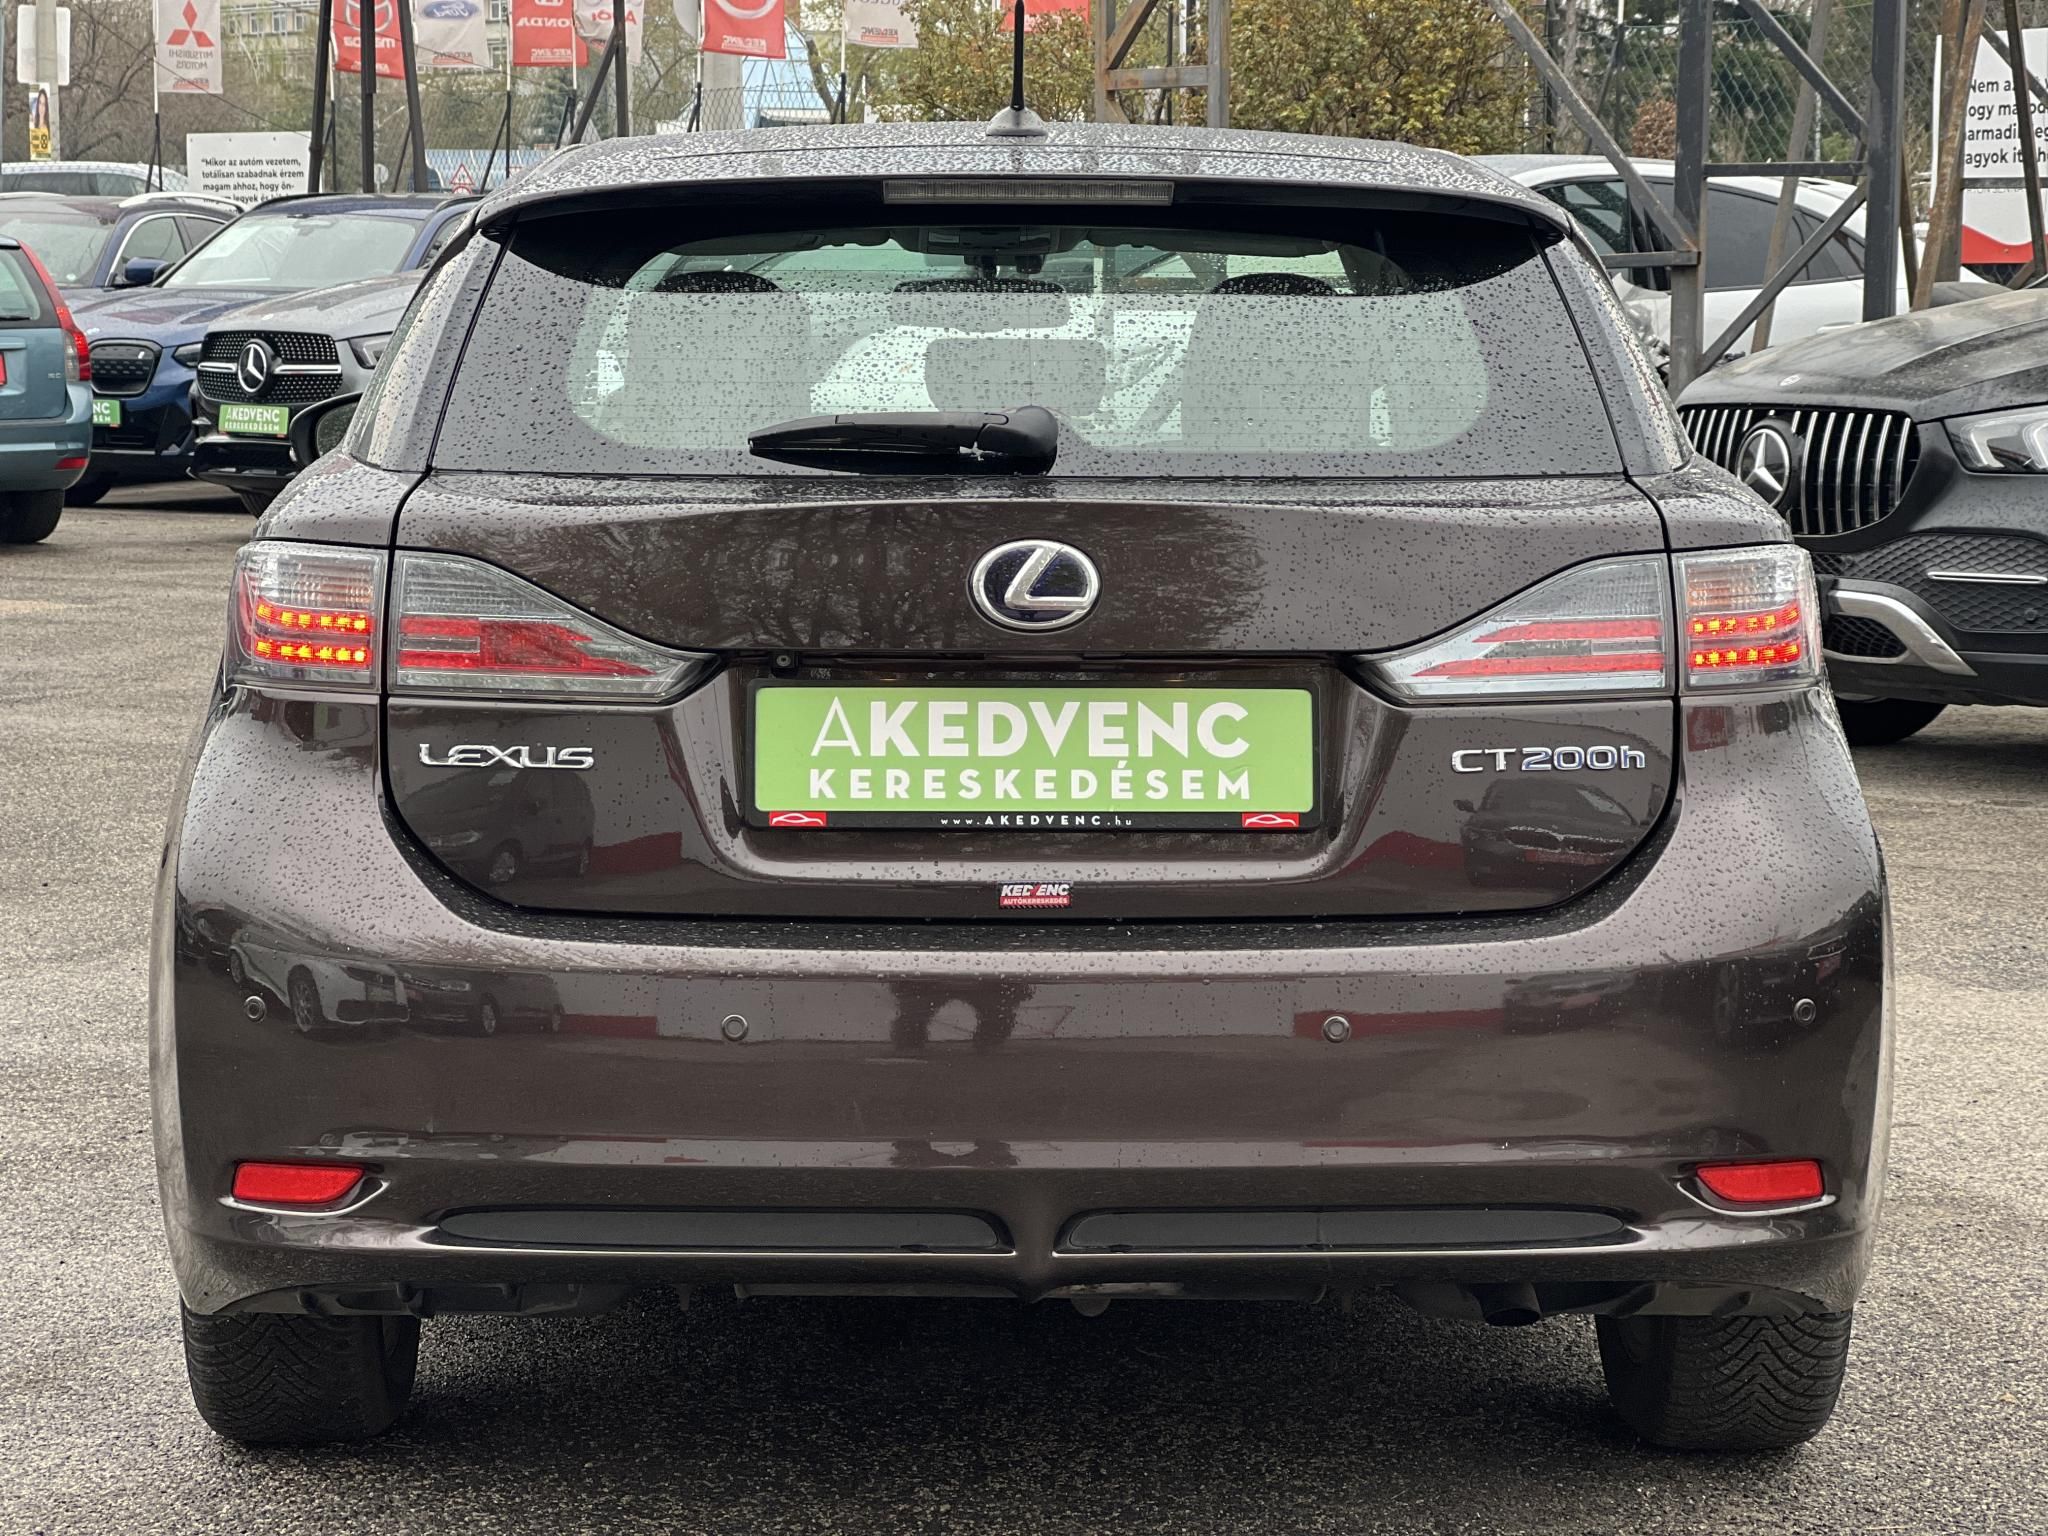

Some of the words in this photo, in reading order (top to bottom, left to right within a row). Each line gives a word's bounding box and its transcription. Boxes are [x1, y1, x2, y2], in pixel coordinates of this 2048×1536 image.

[1968, 104, 1994, 120] ogy
[1967, 123, 2020, 141] armadi
[265, 158, 301, 167] vezetem,
[1965, 148, 2009, 168] agyok
[202, 169, 235, 178] totálisan
[236, 168, 278, 178] szabadnak
[279, 168, 304, 178] érzem
[203, 182, 231, 192] magam
[233, 180, 258, 191] ahhoz,
[259, 180, 279, 191] hogy
[419, 743, 595, 769] LEXUS
[810, 760, 1250, 800] KERESKEDÉSEM
[1001, 883, 1070, 896] KEDVENC
